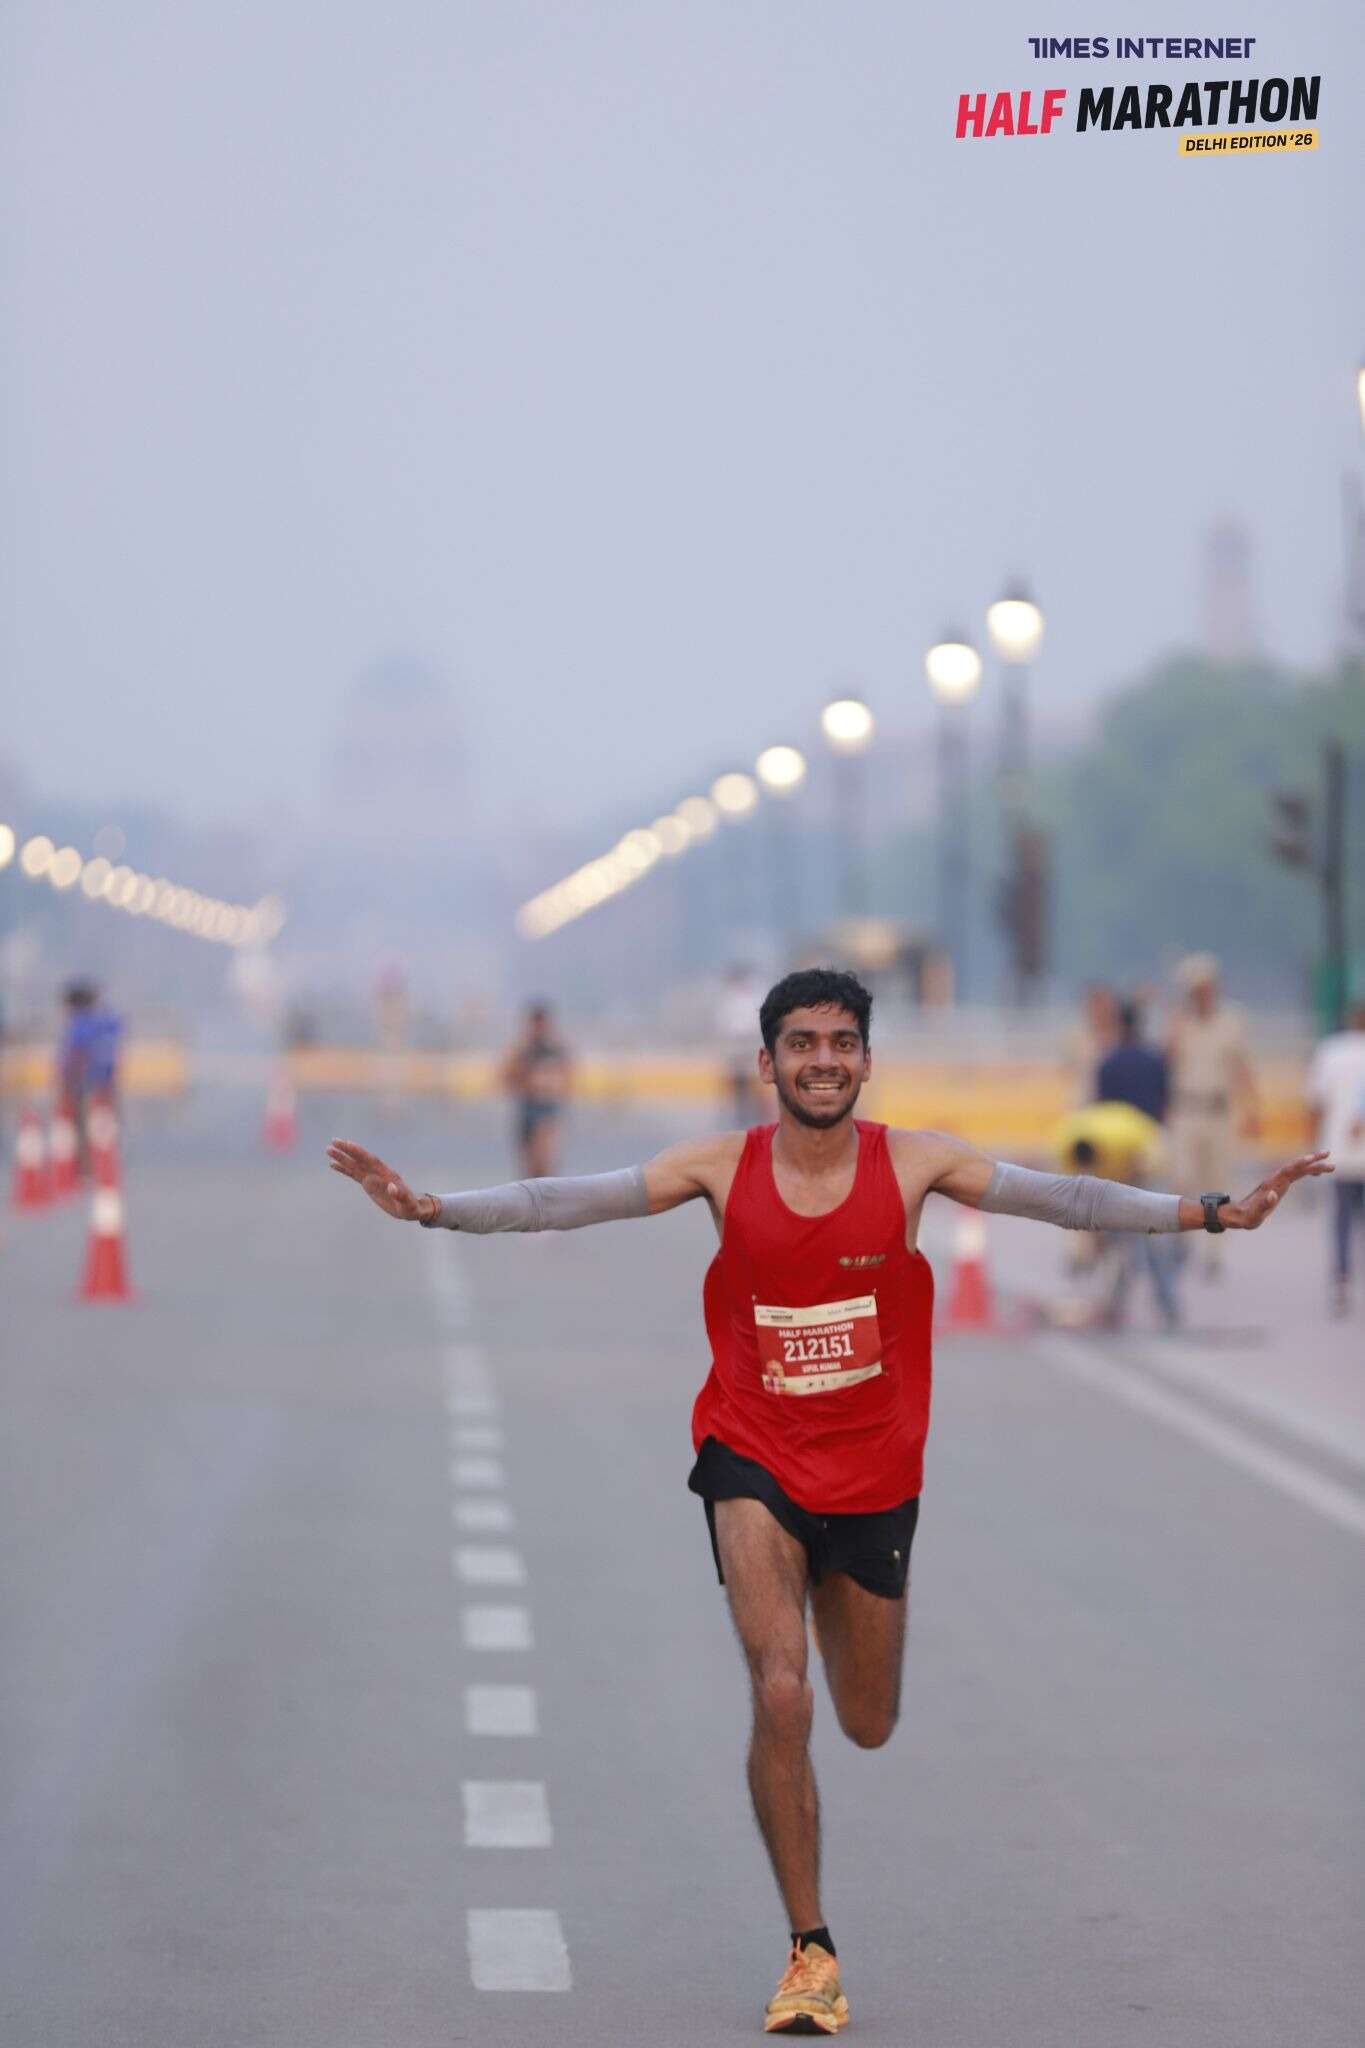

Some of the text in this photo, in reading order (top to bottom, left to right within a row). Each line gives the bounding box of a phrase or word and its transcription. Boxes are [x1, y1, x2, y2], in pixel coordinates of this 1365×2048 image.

[778, 1322, 854, 1338] HALF MARATHON
[784, 1334, 854, 1362] 212151
